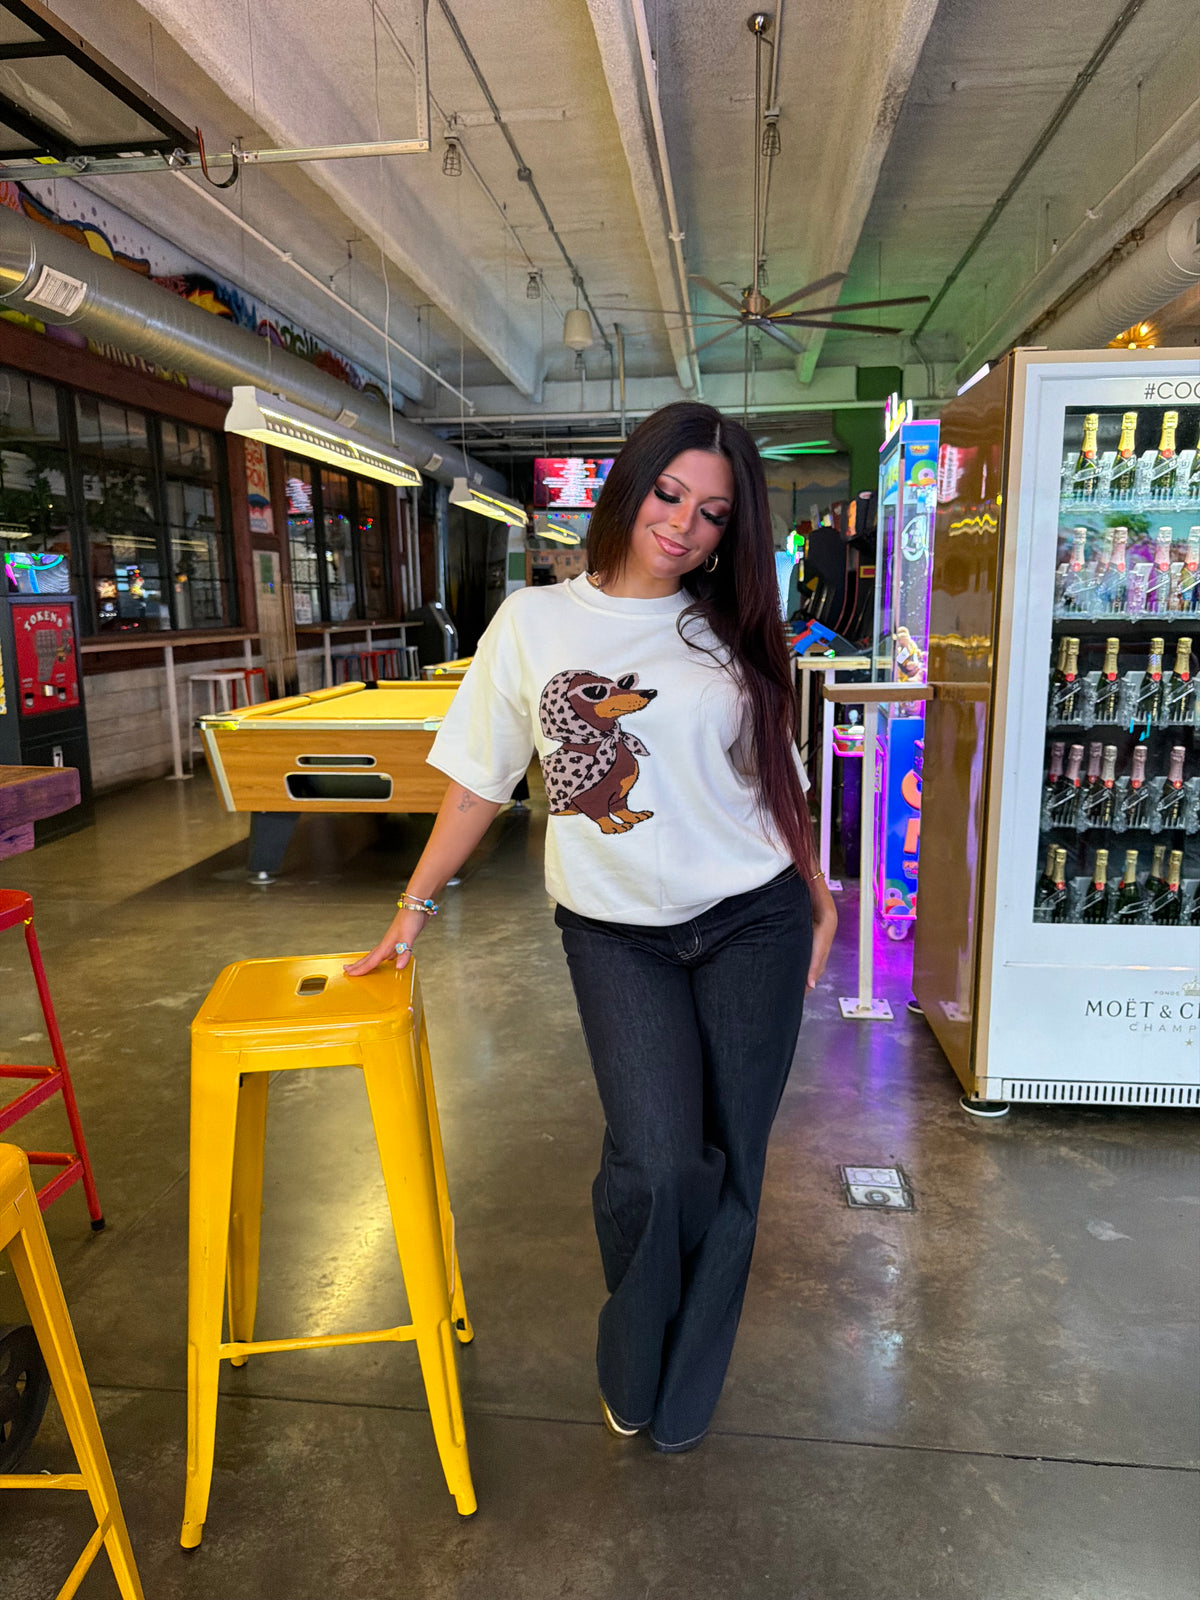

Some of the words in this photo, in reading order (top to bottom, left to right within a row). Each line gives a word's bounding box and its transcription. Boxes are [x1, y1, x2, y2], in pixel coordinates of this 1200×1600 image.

[24, 611, 63, 631] TOKENS
[1085, 998, 1155, 1018] MOËT
[1160, 1005, 1172, 1019] &
[1180, 1002, 1200, 1020] C
